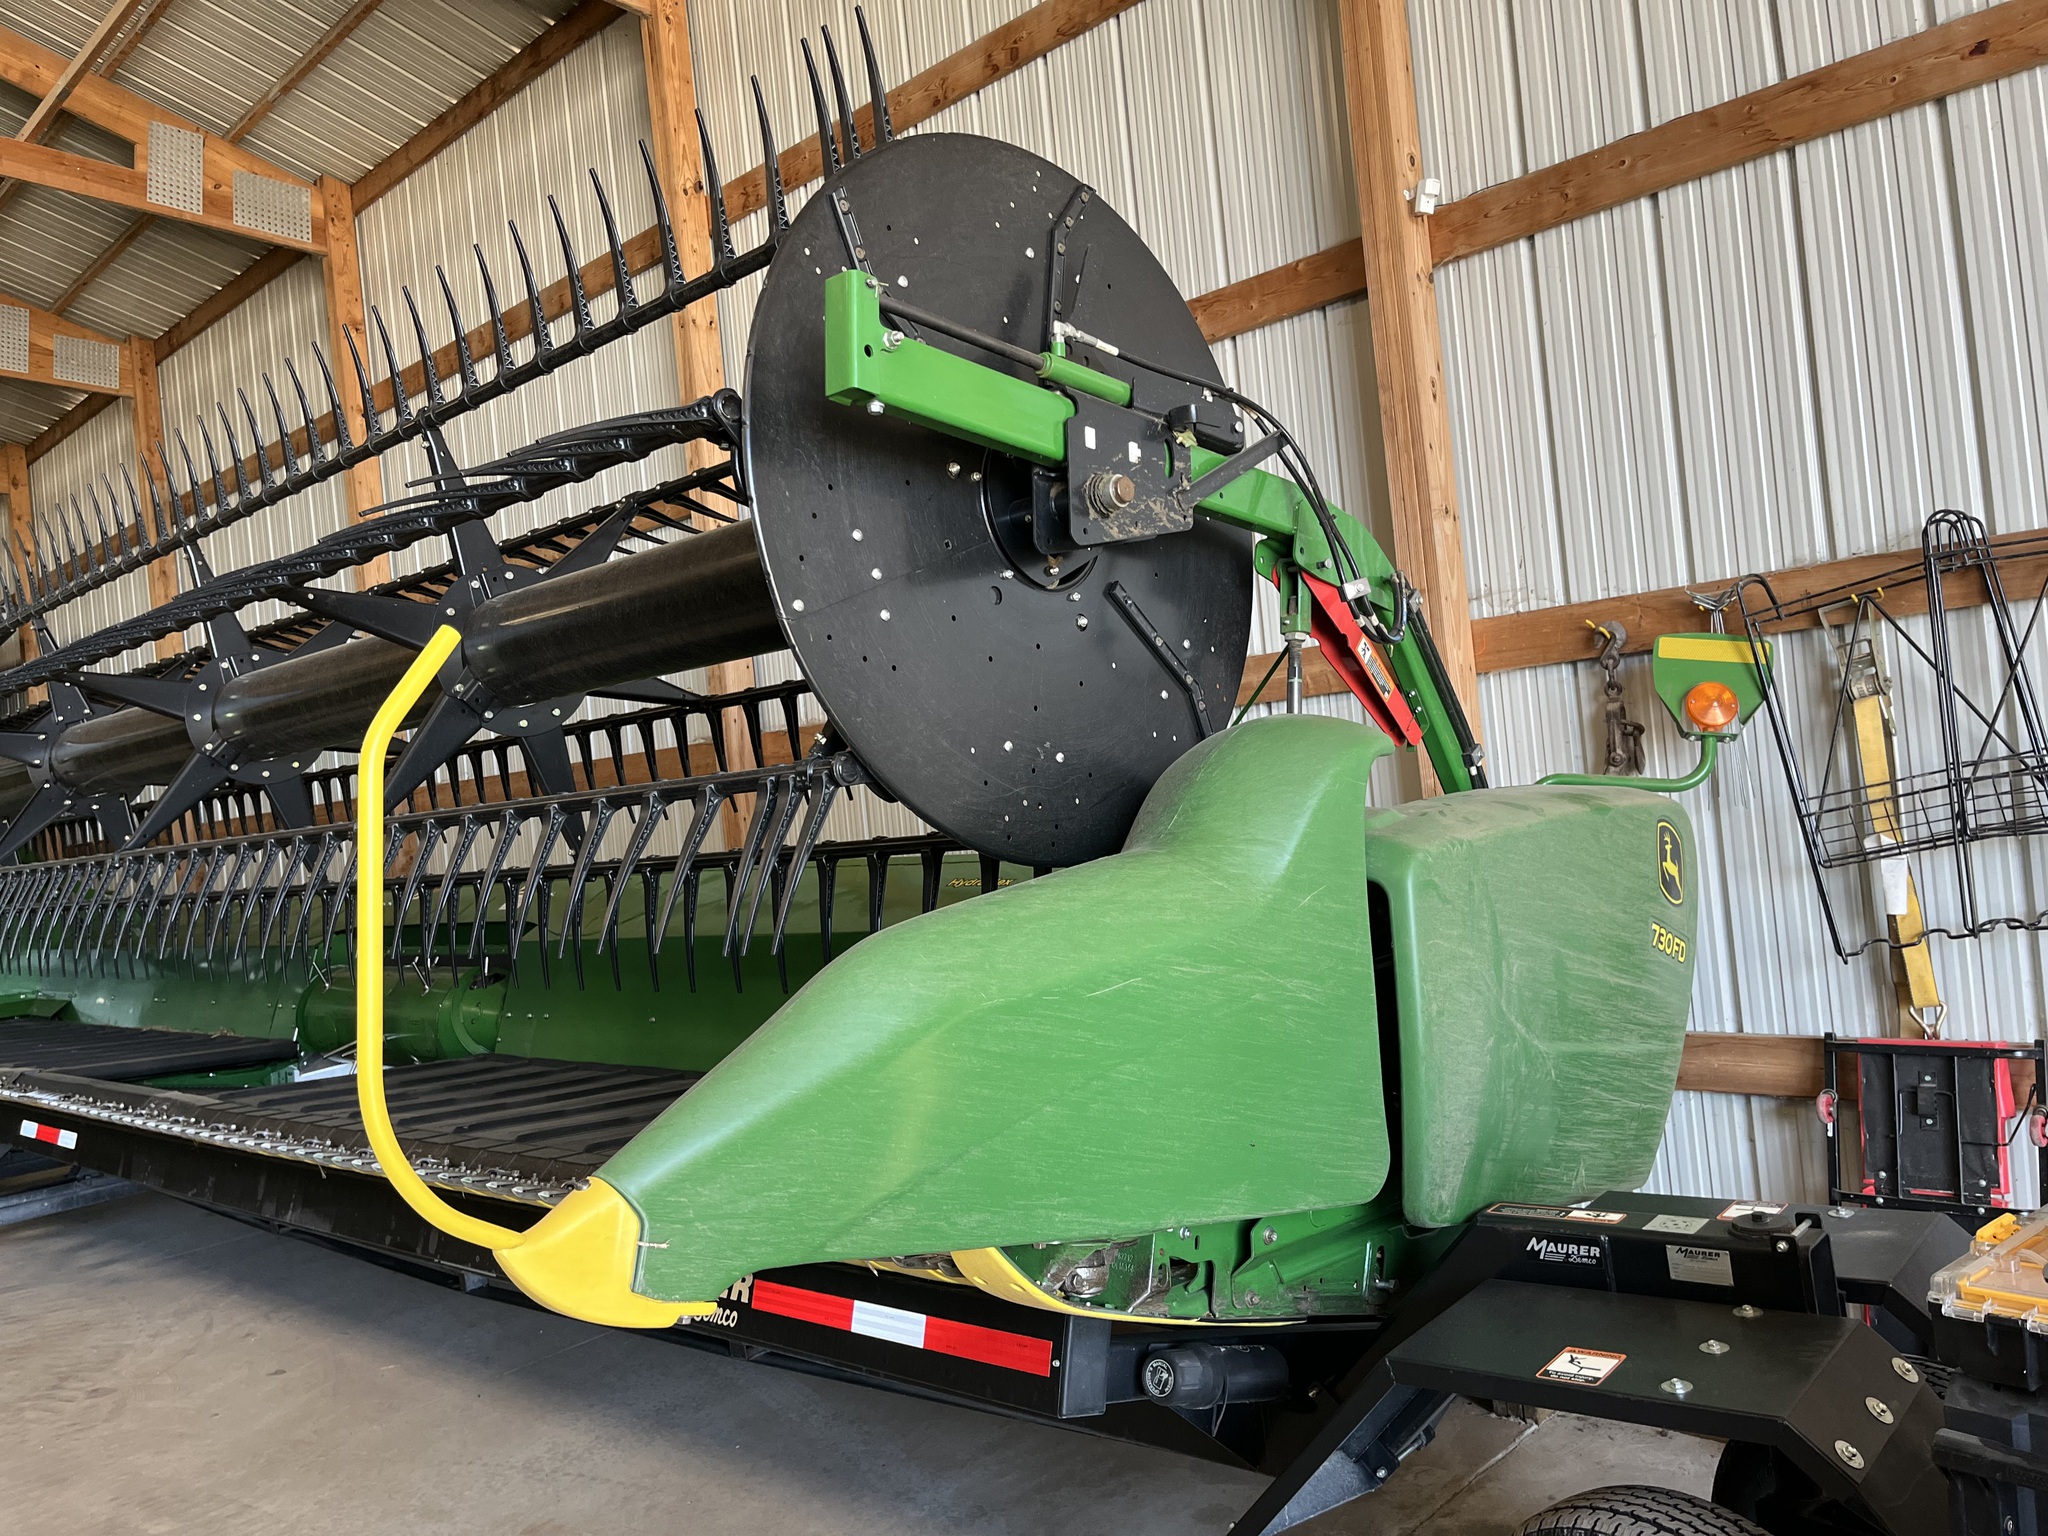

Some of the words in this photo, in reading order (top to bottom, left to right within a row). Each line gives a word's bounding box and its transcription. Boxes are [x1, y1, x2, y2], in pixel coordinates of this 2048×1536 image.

[1651, 921, 1687, 964] 730FD
[1526, 1237, 1601, 1260] MAURER
[1675, 1247, 1720, 1258] MAURER
[1568, 1254, 1597, 1265] Demco
